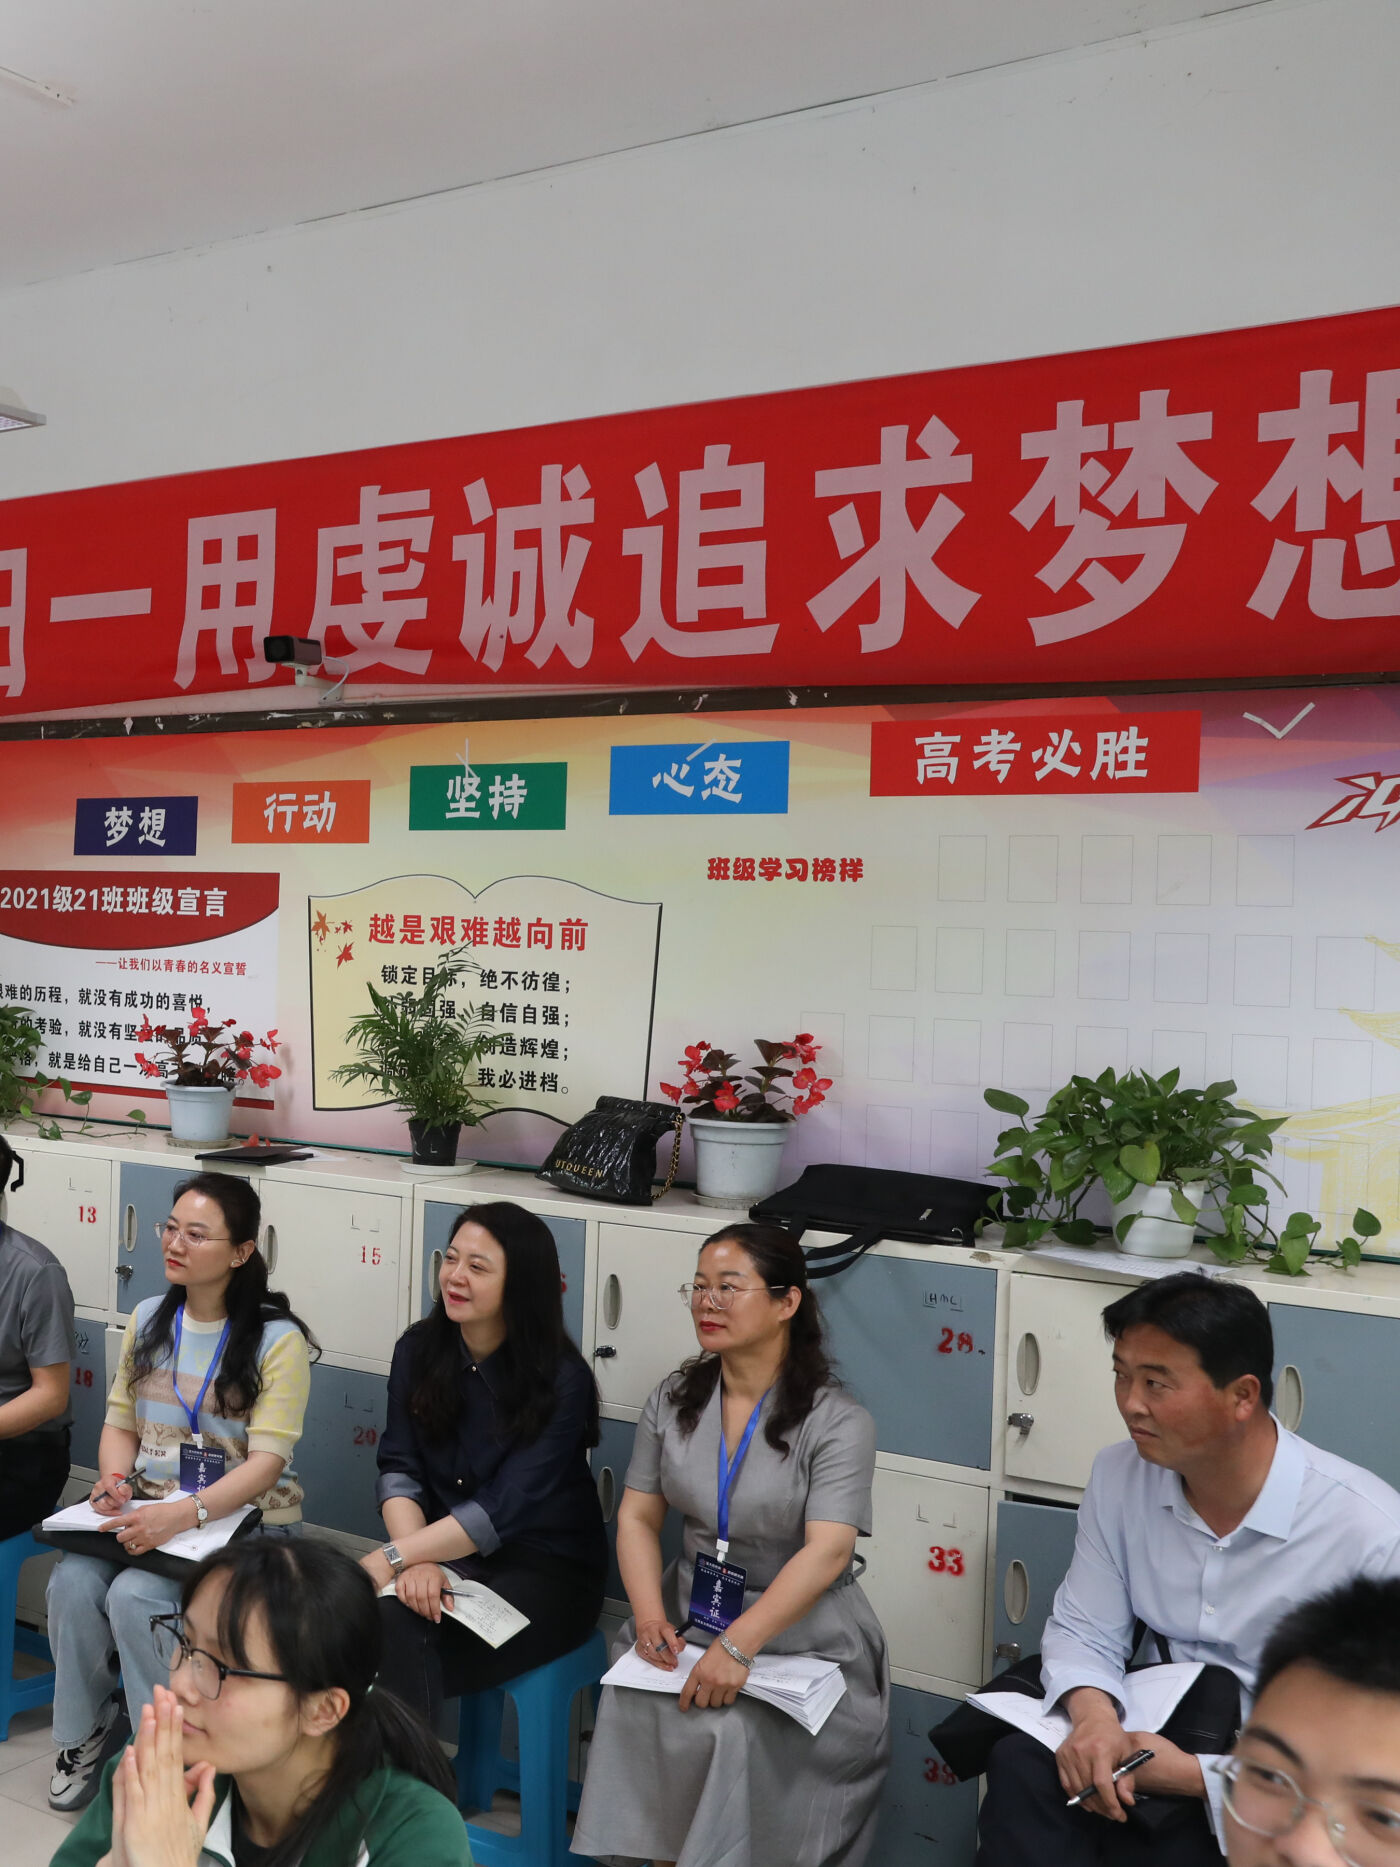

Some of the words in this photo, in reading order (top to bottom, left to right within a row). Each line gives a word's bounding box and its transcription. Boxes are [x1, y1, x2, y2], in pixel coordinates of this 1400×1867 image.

[915, 726, 1149, 784] 高考必胜
[446, 773, 528, 820] 坚持
[652, 754, 743, 803] 心态
[104, 806, 166, 847] 梦想
[264, 790, 336, 834] 行动
[707, 857, 864, 883] 班级学习榜样
[368, 913, 589, 951] 越是艰难越向前
[78, 1205, 97, 1224] 13
[361, 1245, 382, 1265] 15
[352, 1425, 378, 1447] 20
[927, 1545, 964, 1577] 33
